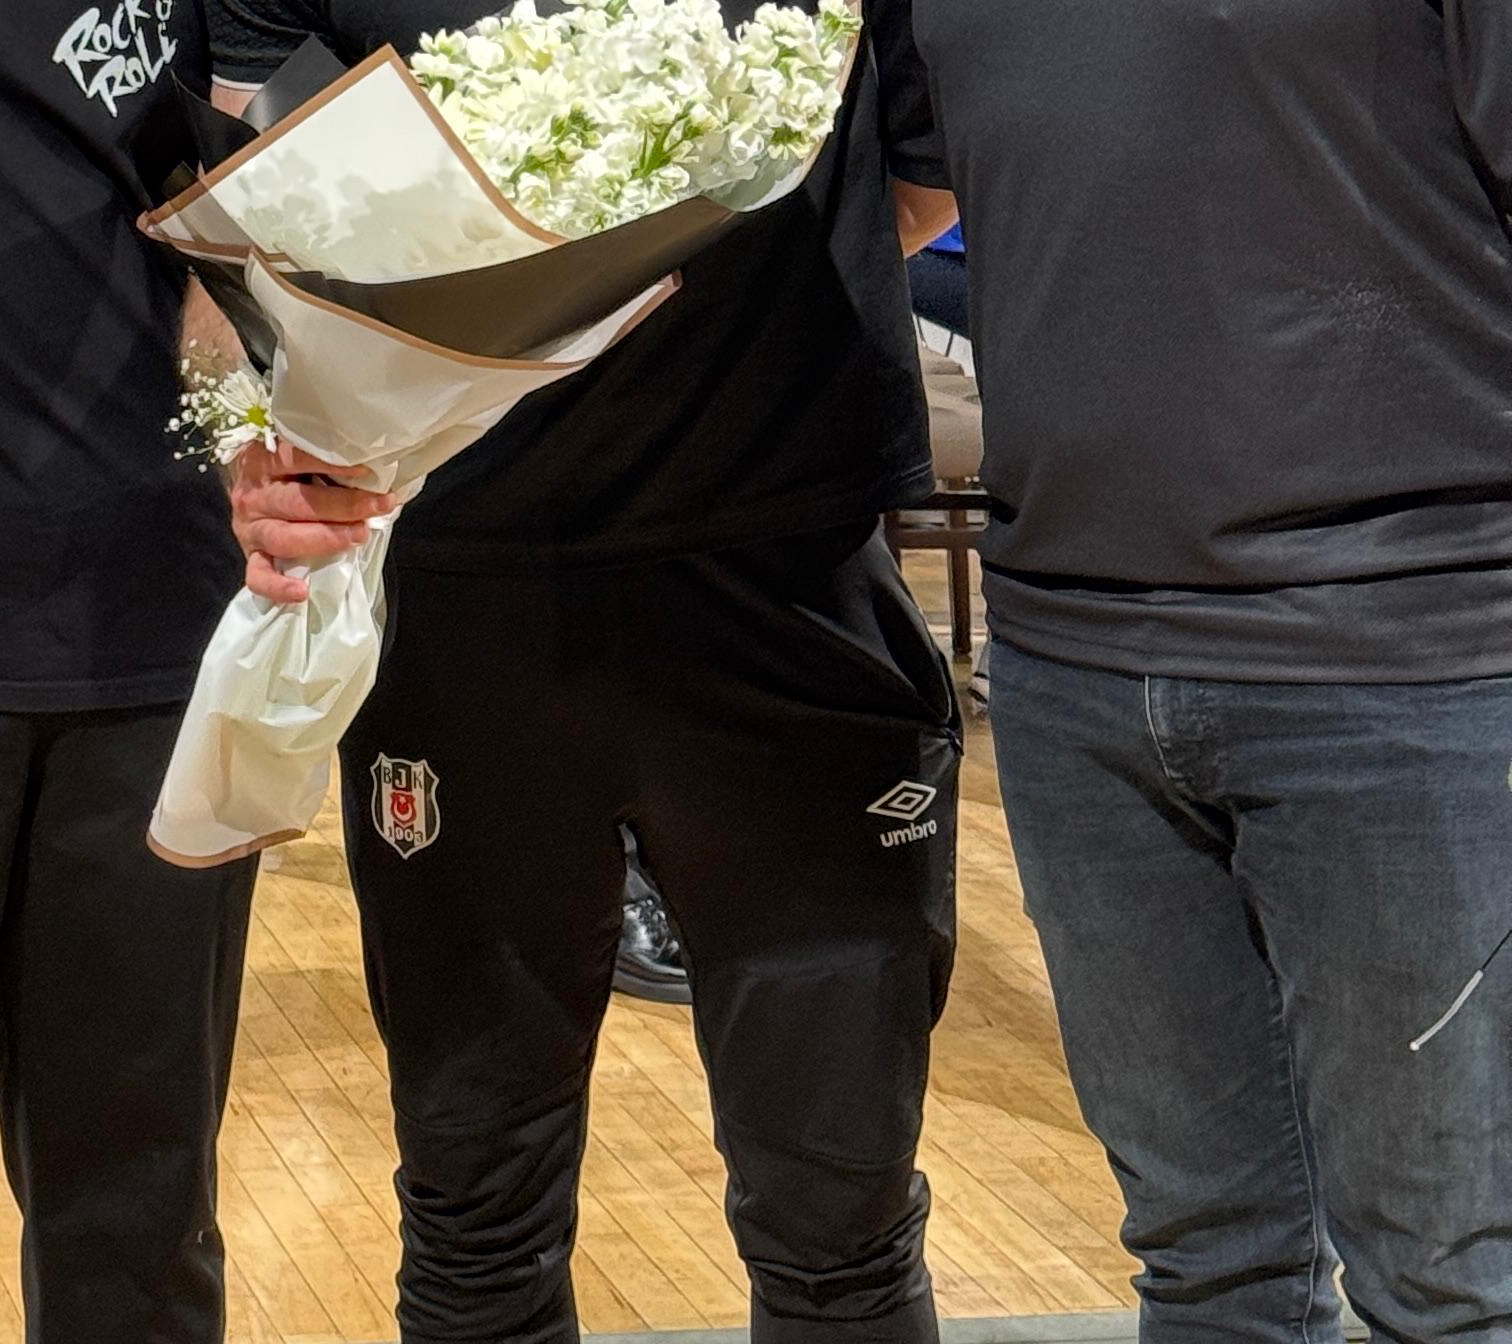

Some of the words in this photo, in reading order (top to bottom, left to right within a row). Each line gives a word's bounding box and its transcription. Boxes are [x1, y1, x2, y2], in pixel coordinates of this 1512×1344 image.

[382, 766, 424, 790] BJK
[387, 826, 424, 843] 1903
[879, 820, 938, 848] umbro
